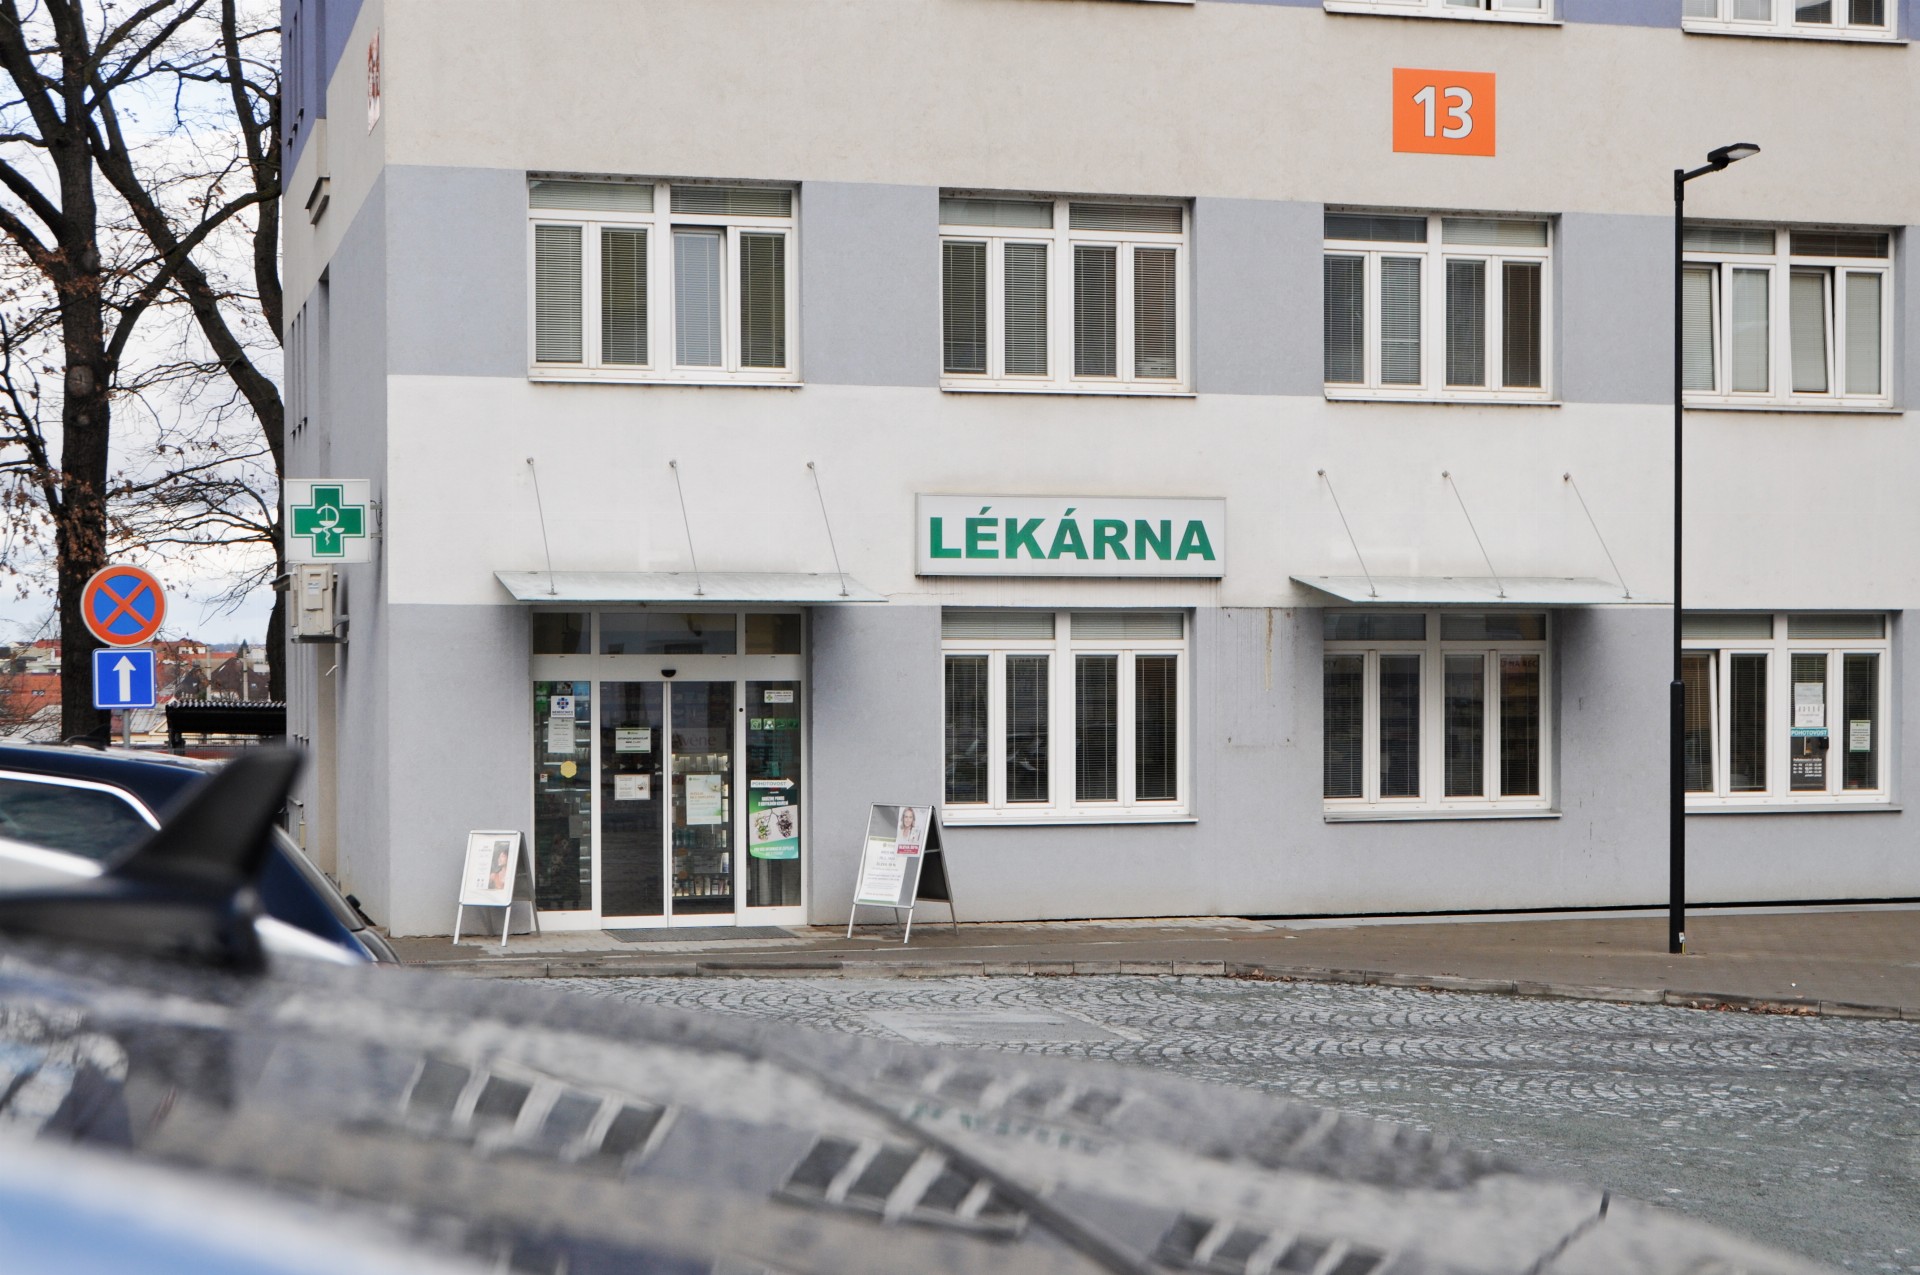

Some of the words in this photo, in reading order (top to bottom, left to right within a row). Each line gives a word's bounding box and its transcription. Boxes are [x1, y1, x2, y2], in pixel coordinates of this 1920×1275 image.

[1411, 84, 1474, 139] 13
[929, 506, 1217, 561] LÉKÁRNA
[1791, 729, 1827, 737] POHOTOVOST
